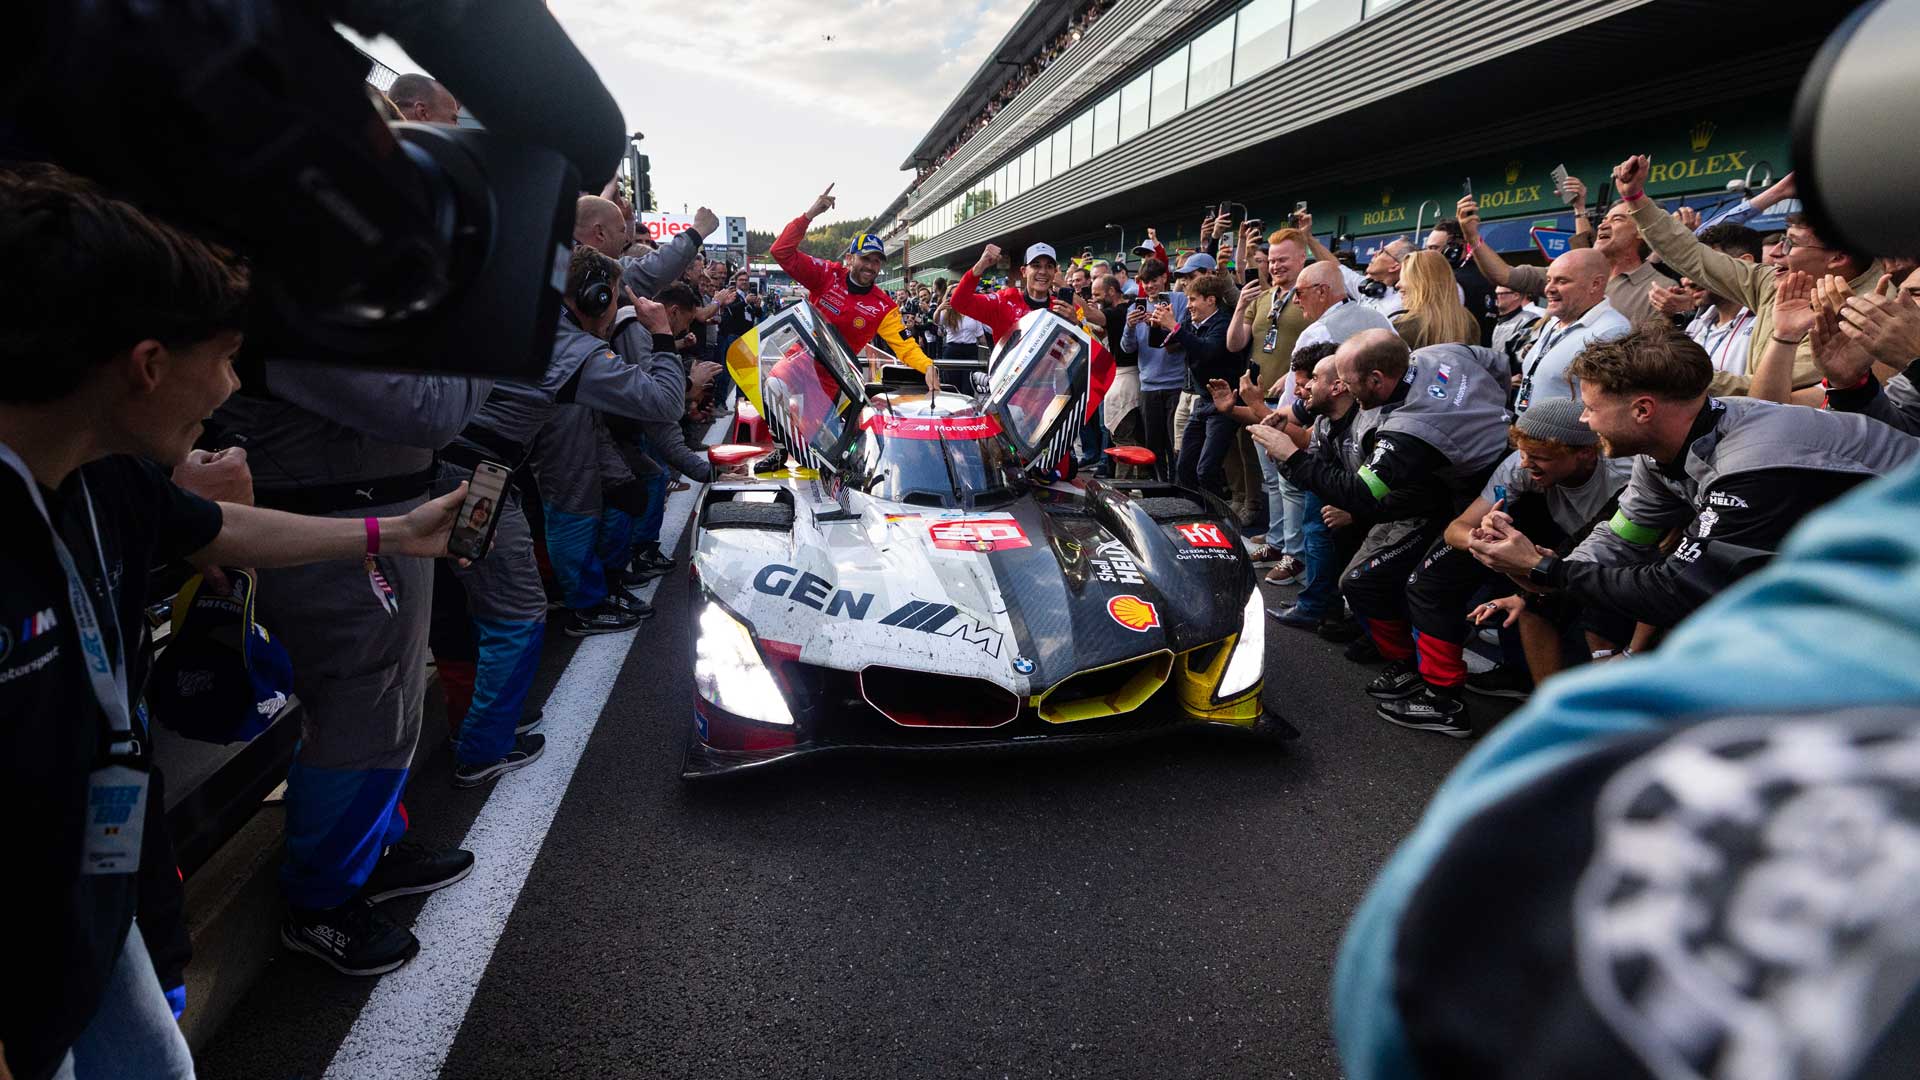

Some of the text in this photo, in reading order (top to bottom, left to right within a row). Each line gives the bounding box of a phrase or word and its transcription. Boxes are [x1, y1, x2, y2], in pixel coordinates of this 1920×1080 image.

[1650, 151, 1747, 183] ROLEX
[1479, 185, 1542, 208] ROLEX
[1363, 208, 1407, 225] ROLEX
[1548, 239, 1565, 250] 15
[934, 423, 989, 432] Motorsport
[1709, 495, 1749, 508] HELIX
[1181, 527, 1222, 543] HY
[1381, 535, 1422, 562] Motorsport
[1091, 559, 1117, 583] Shell
[1096, 539, 1145, 585] HELIX
[752, 563, 875, 621] GEN
